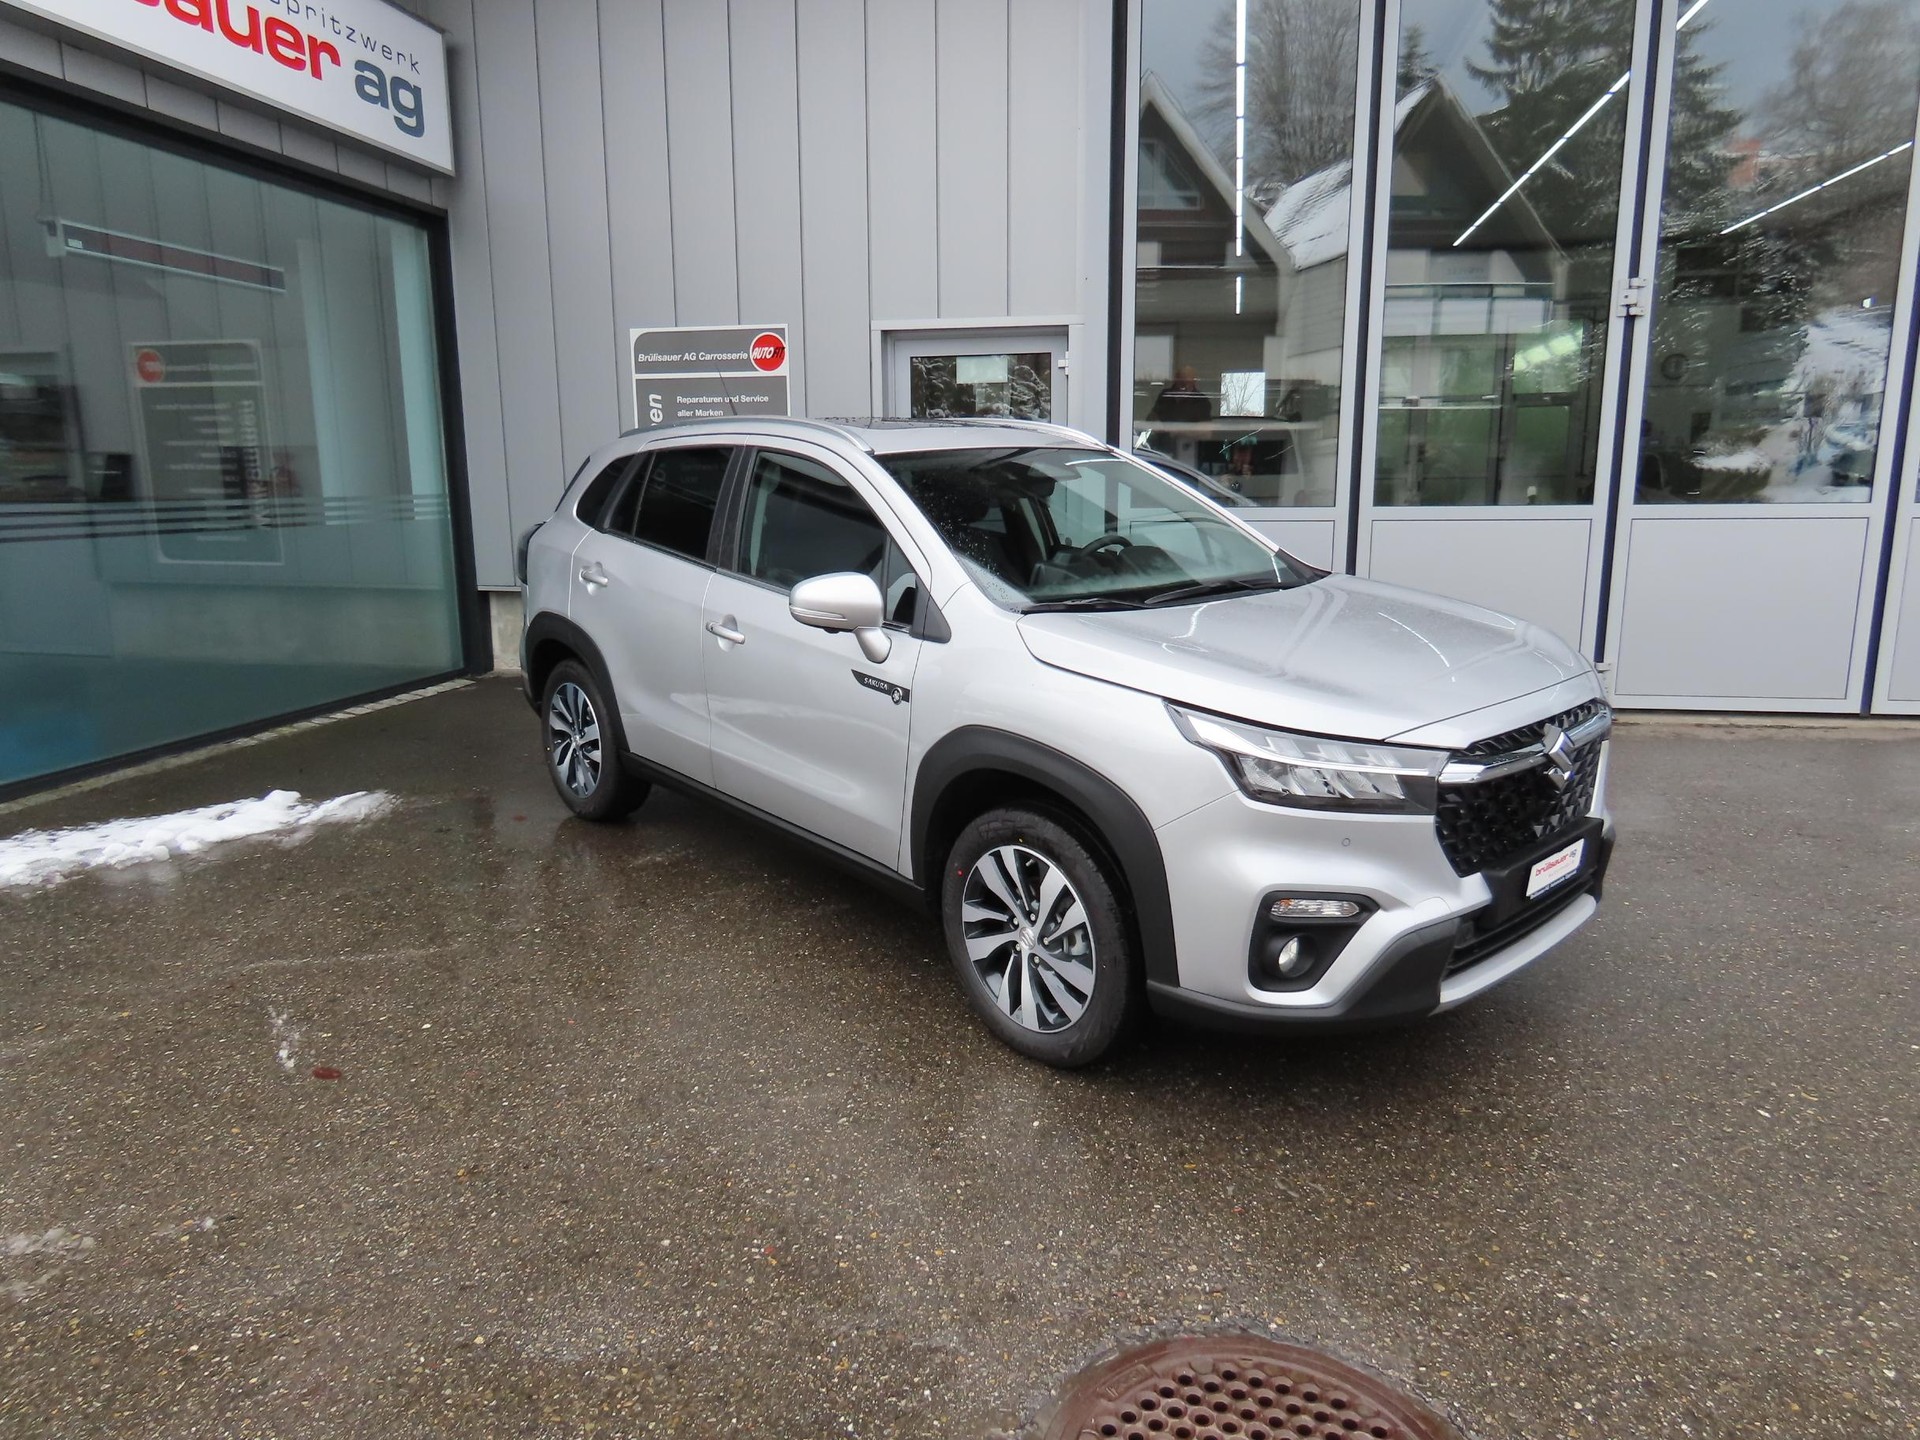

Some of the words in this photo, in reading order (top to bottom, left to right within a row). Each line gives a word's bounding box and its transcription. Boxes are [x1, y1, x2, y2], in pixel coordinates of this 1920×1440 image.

[133, 0, 341, 81] auer
[354, 59, 425, 138] ag
[638, 353, 682, 362] Brülisauer
[683, 352, 697, 361] AG
[698, 351, 748, 360] Carrosserie
[676, 396, 723, 404] Reparaturen
[725, 395, 739, 403] und
[649, 394, 663, 427] en
[695, 409, 724, 417] Marken
[864, 677, 888, 690] SAKURA
